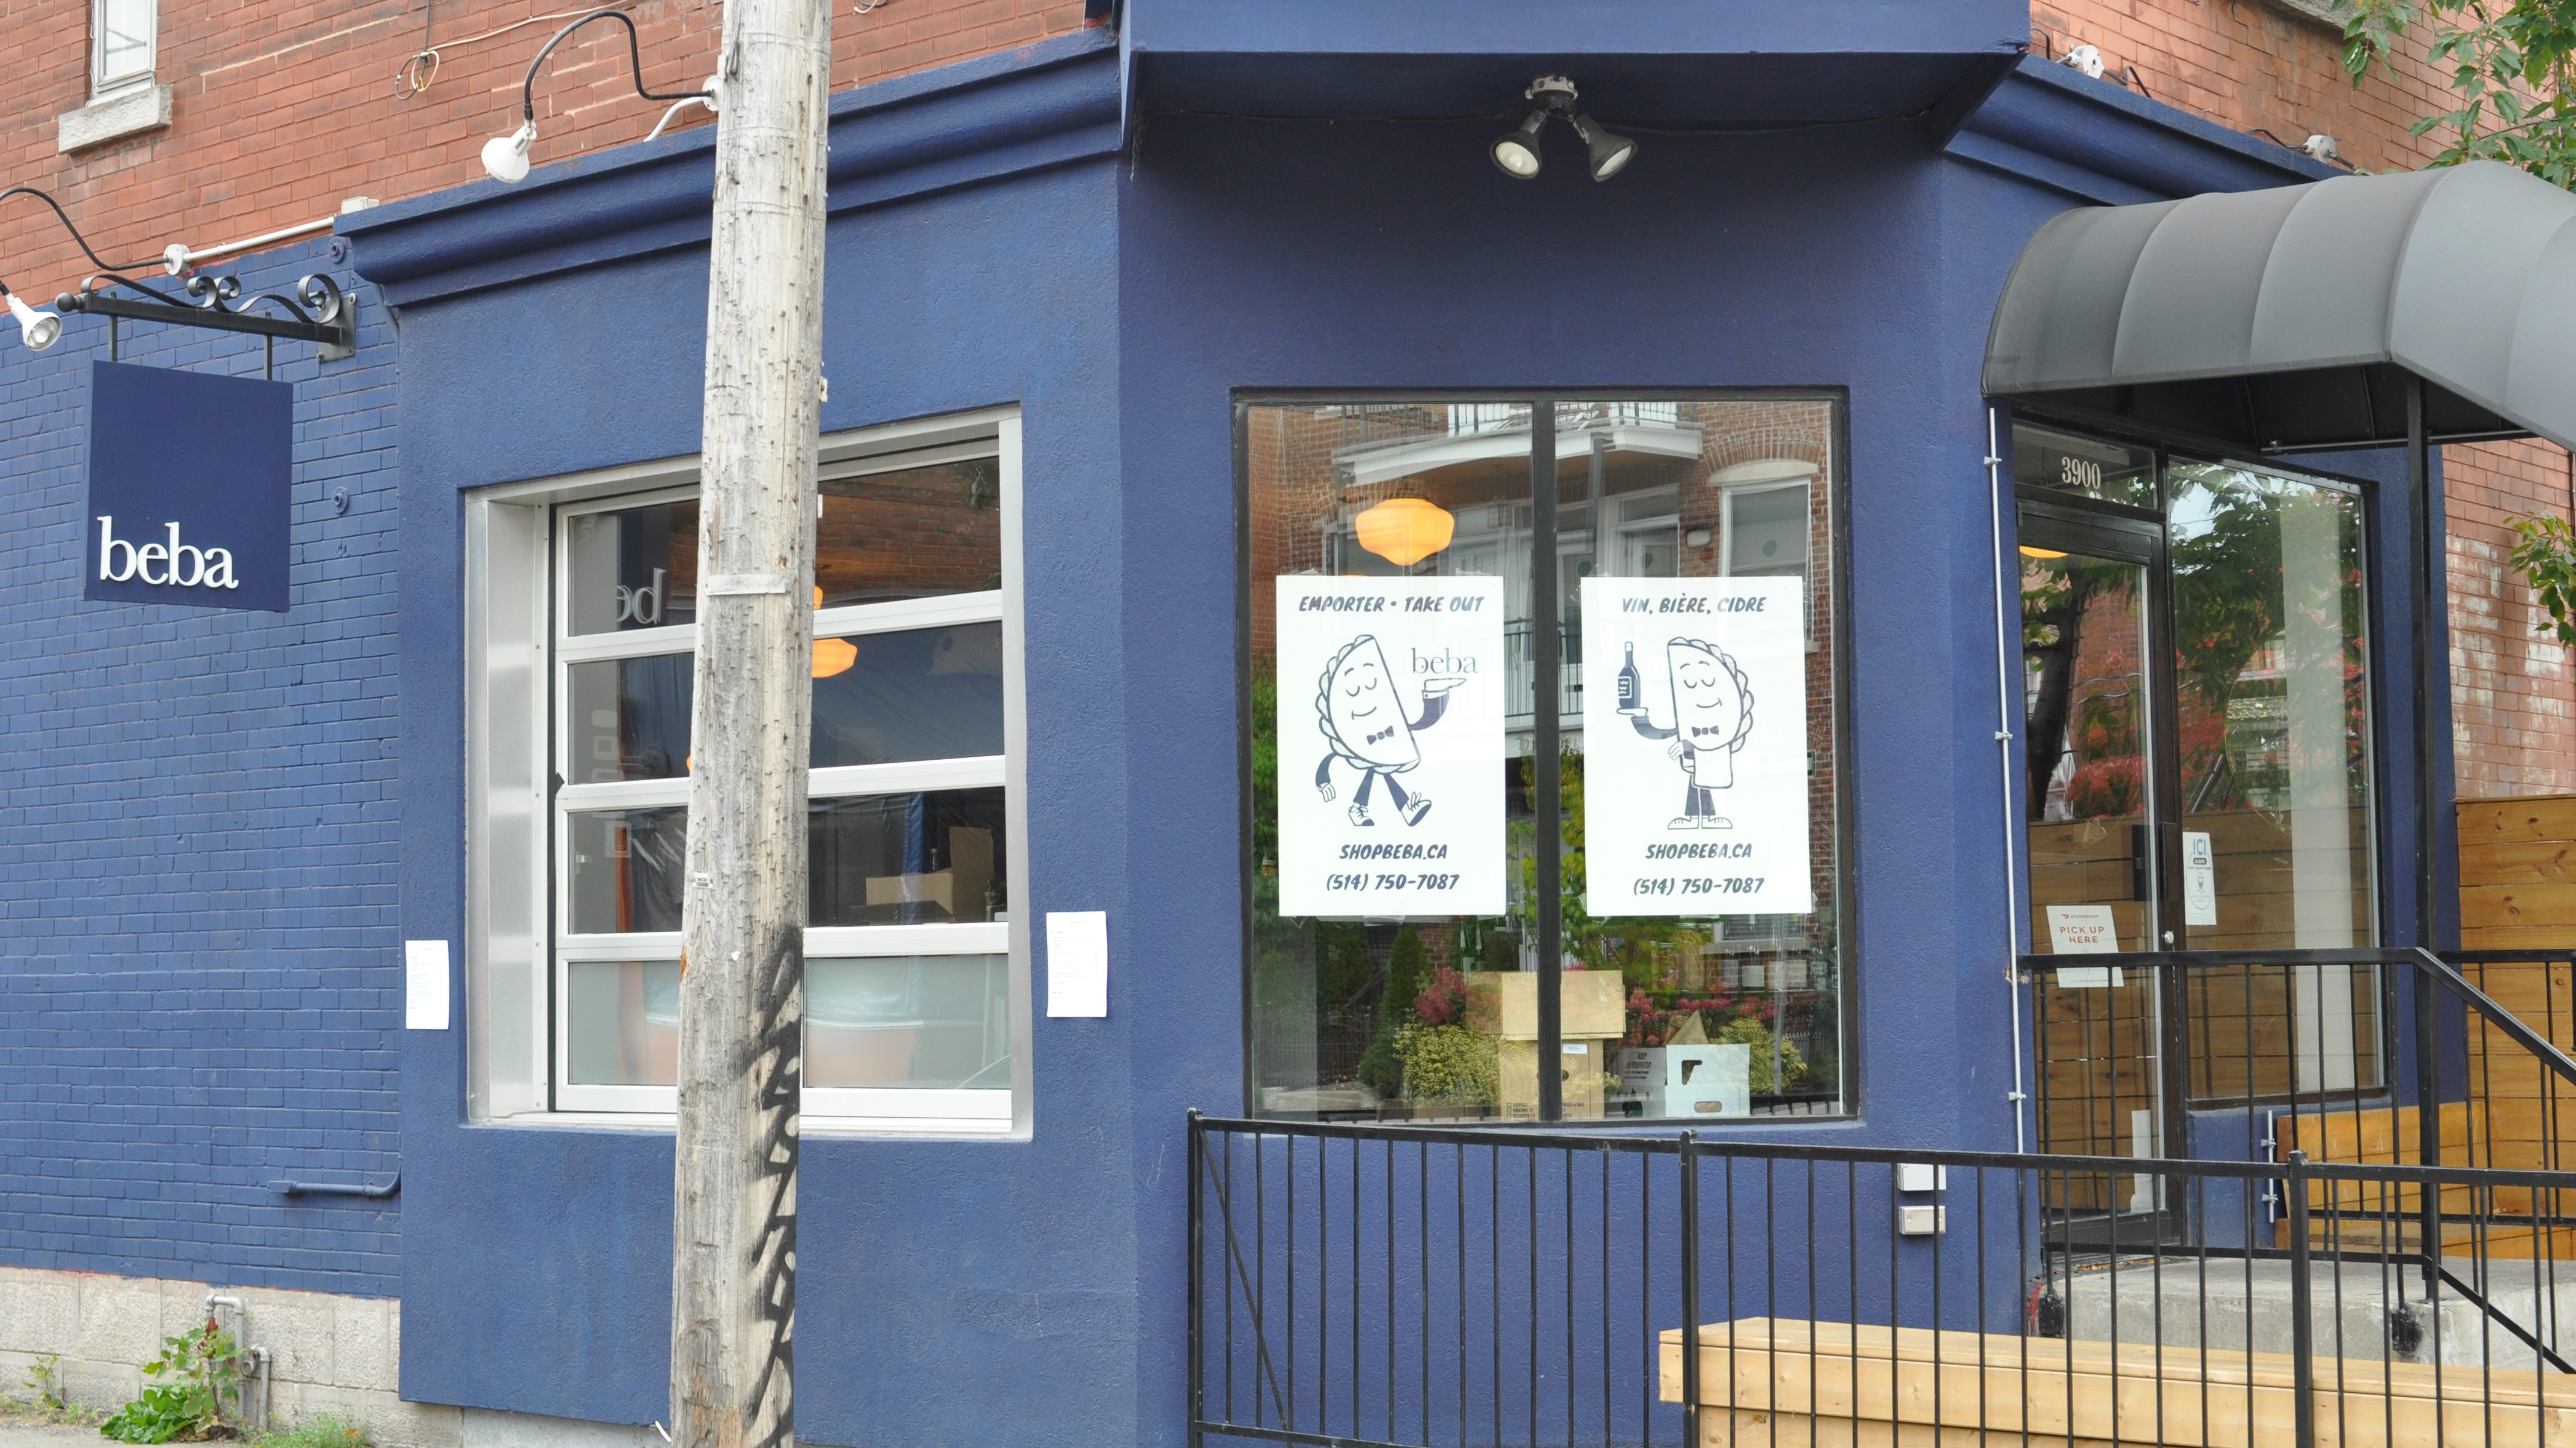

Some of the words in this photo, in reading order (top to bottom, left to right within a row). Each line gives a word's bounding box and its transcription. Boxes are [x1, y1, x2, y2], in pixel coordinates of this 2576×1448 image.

[2062, 456, 2101, 489] 3900
[97, 515, 239, 589] beba
[1299, 596, 1384, 612] EMPORTER
[1405, 596, 1443, 612] TAKE
[1449, 596, 1485, 612] OUT
[1622, 597, 1653, 614] VIN,
[1659, 593, 1712, 614] BIÈRE,
[1717, 596, 1767, 613] CIDRE
[1411, 647, 1479, 674] beba
[1338, 844, 1448, 860] SHOPBEBA.CA
[1645, 843, 1752, 859] SHOPBEBA.CA
[2193, 838, 2206, 856] ICI
[1326, 873, 1369, 892] (514)
[1375, 873, 1460, 890] 750-7087
[1633, 877, 1675, 895] (514)
[1681, 877, 1765, 894] 750-7087
